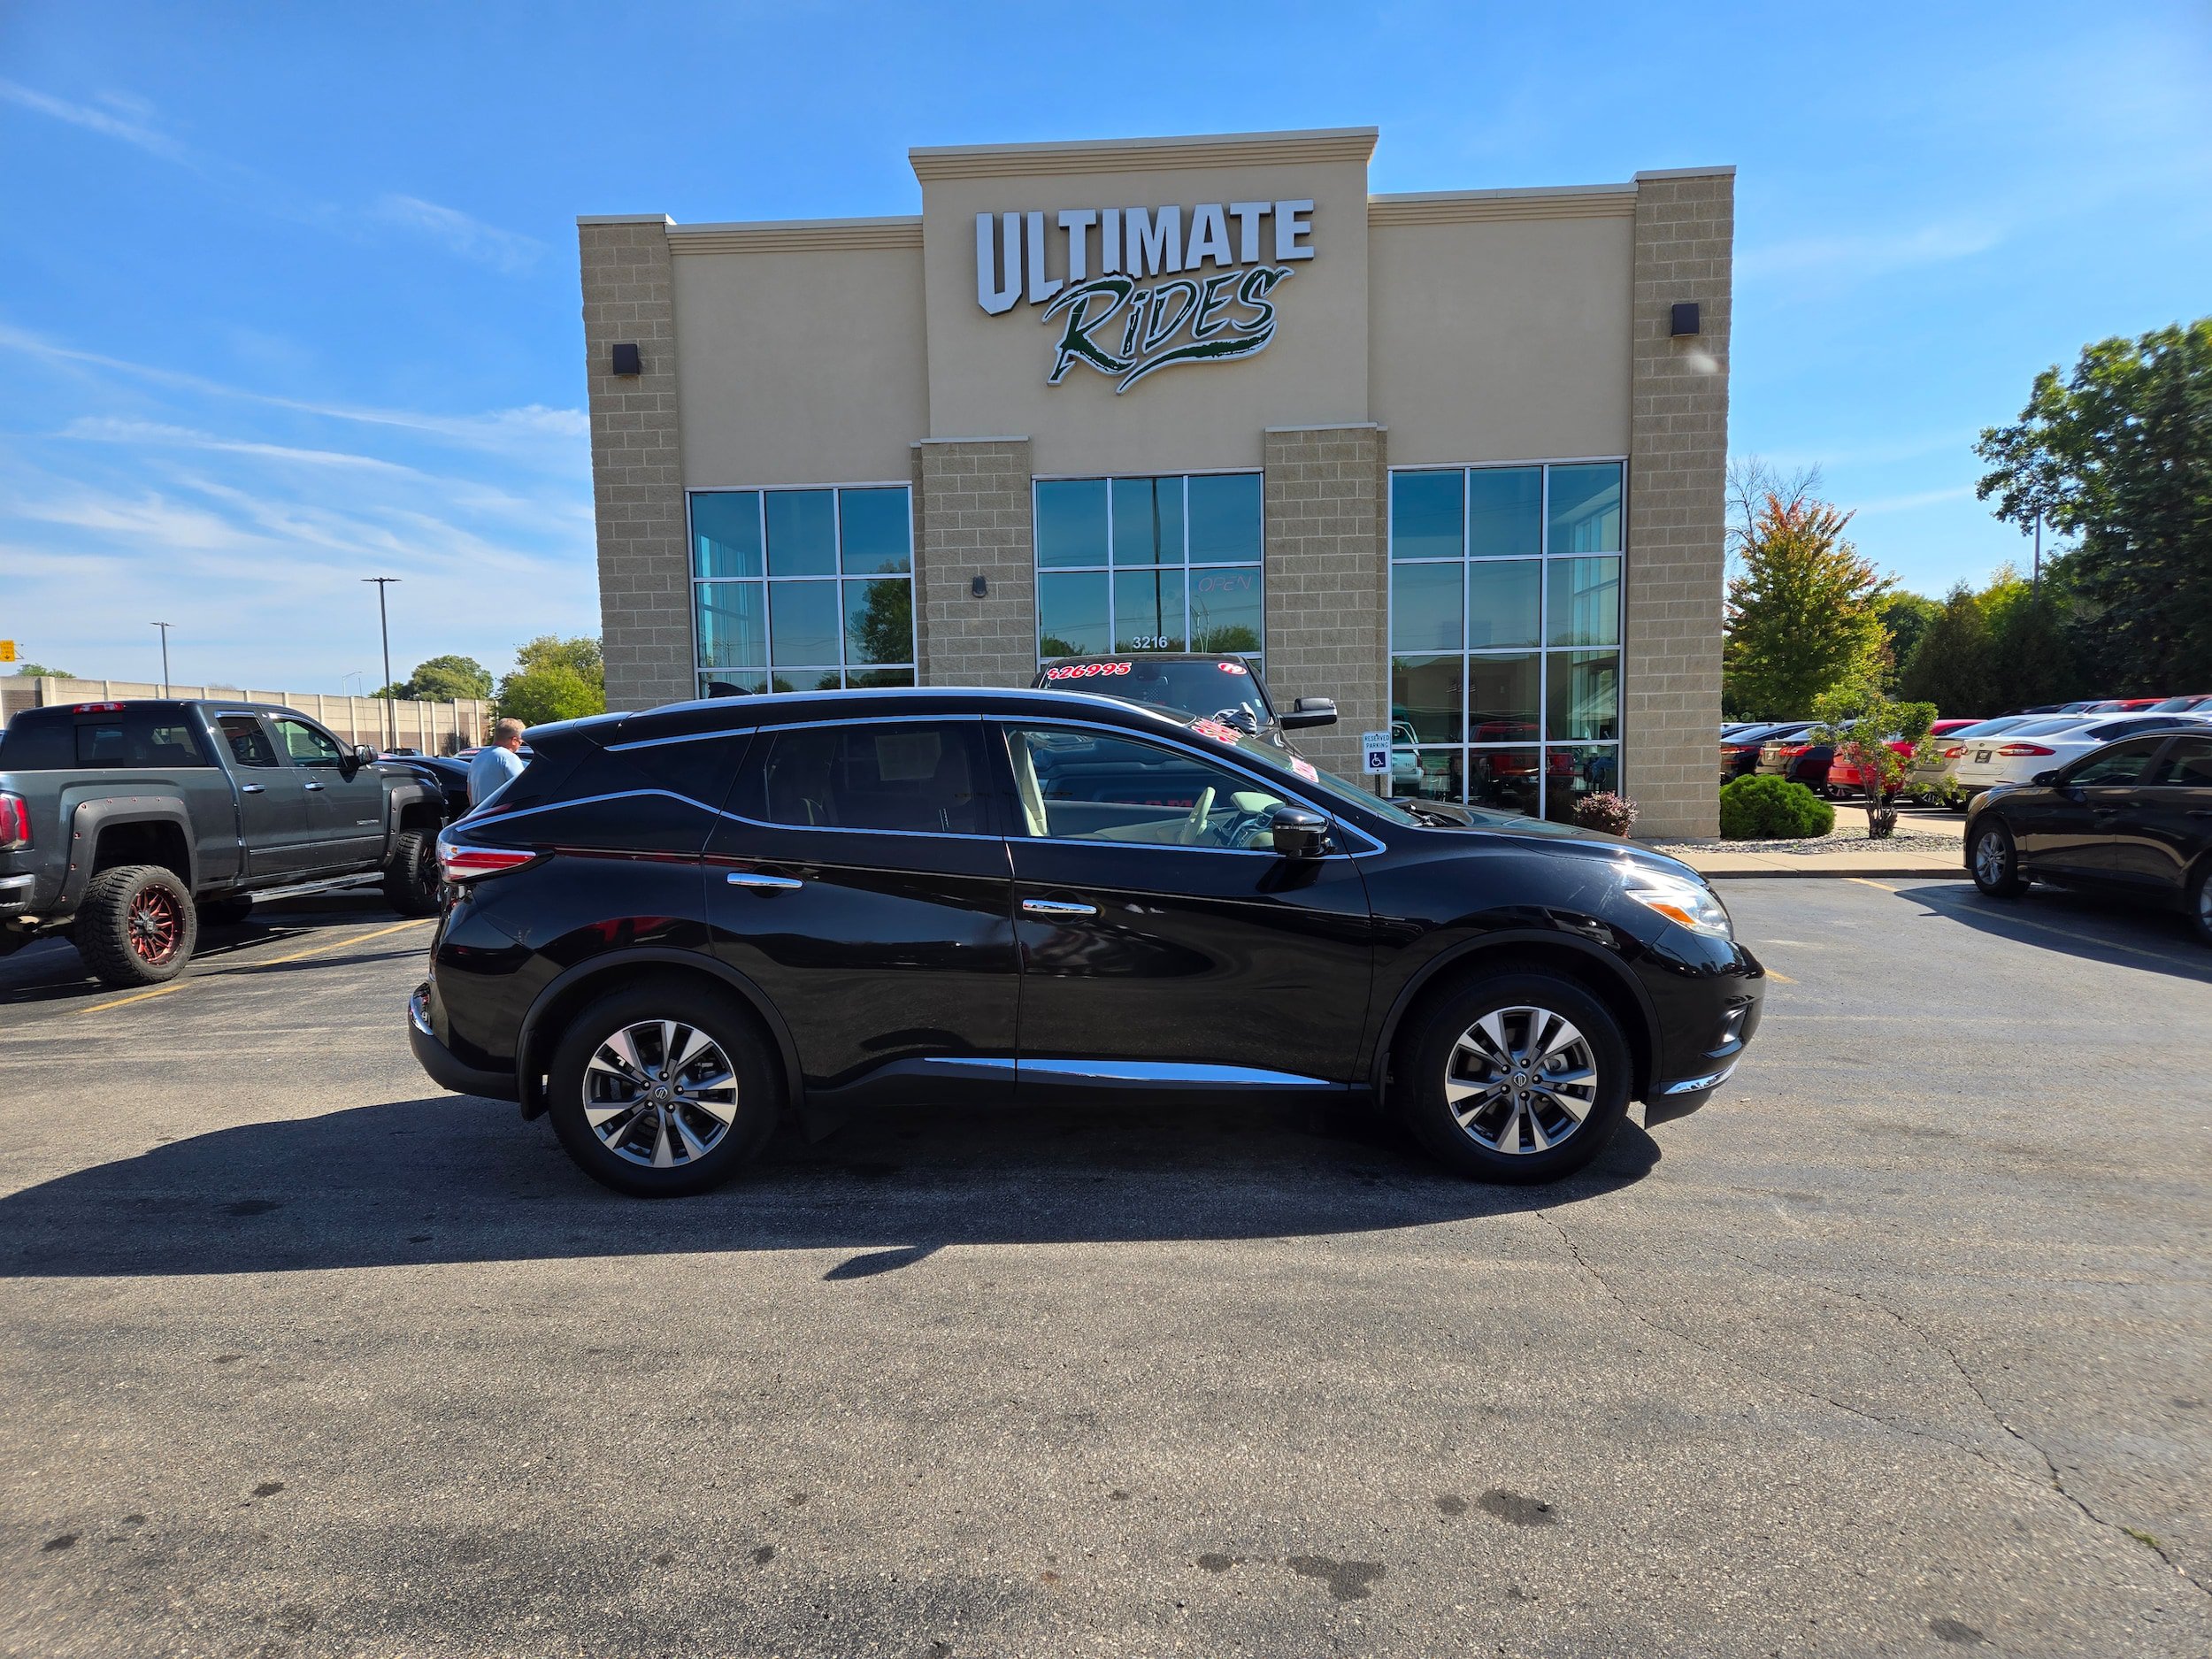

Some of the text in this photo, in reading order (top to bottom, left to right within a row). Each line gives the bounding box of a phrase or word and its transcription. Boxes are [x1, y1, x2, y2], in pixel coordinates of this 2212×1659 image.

[976, 199, 1314, 316] ULTIMATE
[1198, 575, 1252, 592] OPEN
[1133, 636, 1168, 649] 3216
[1047, 662, 1133, 680] $26995
